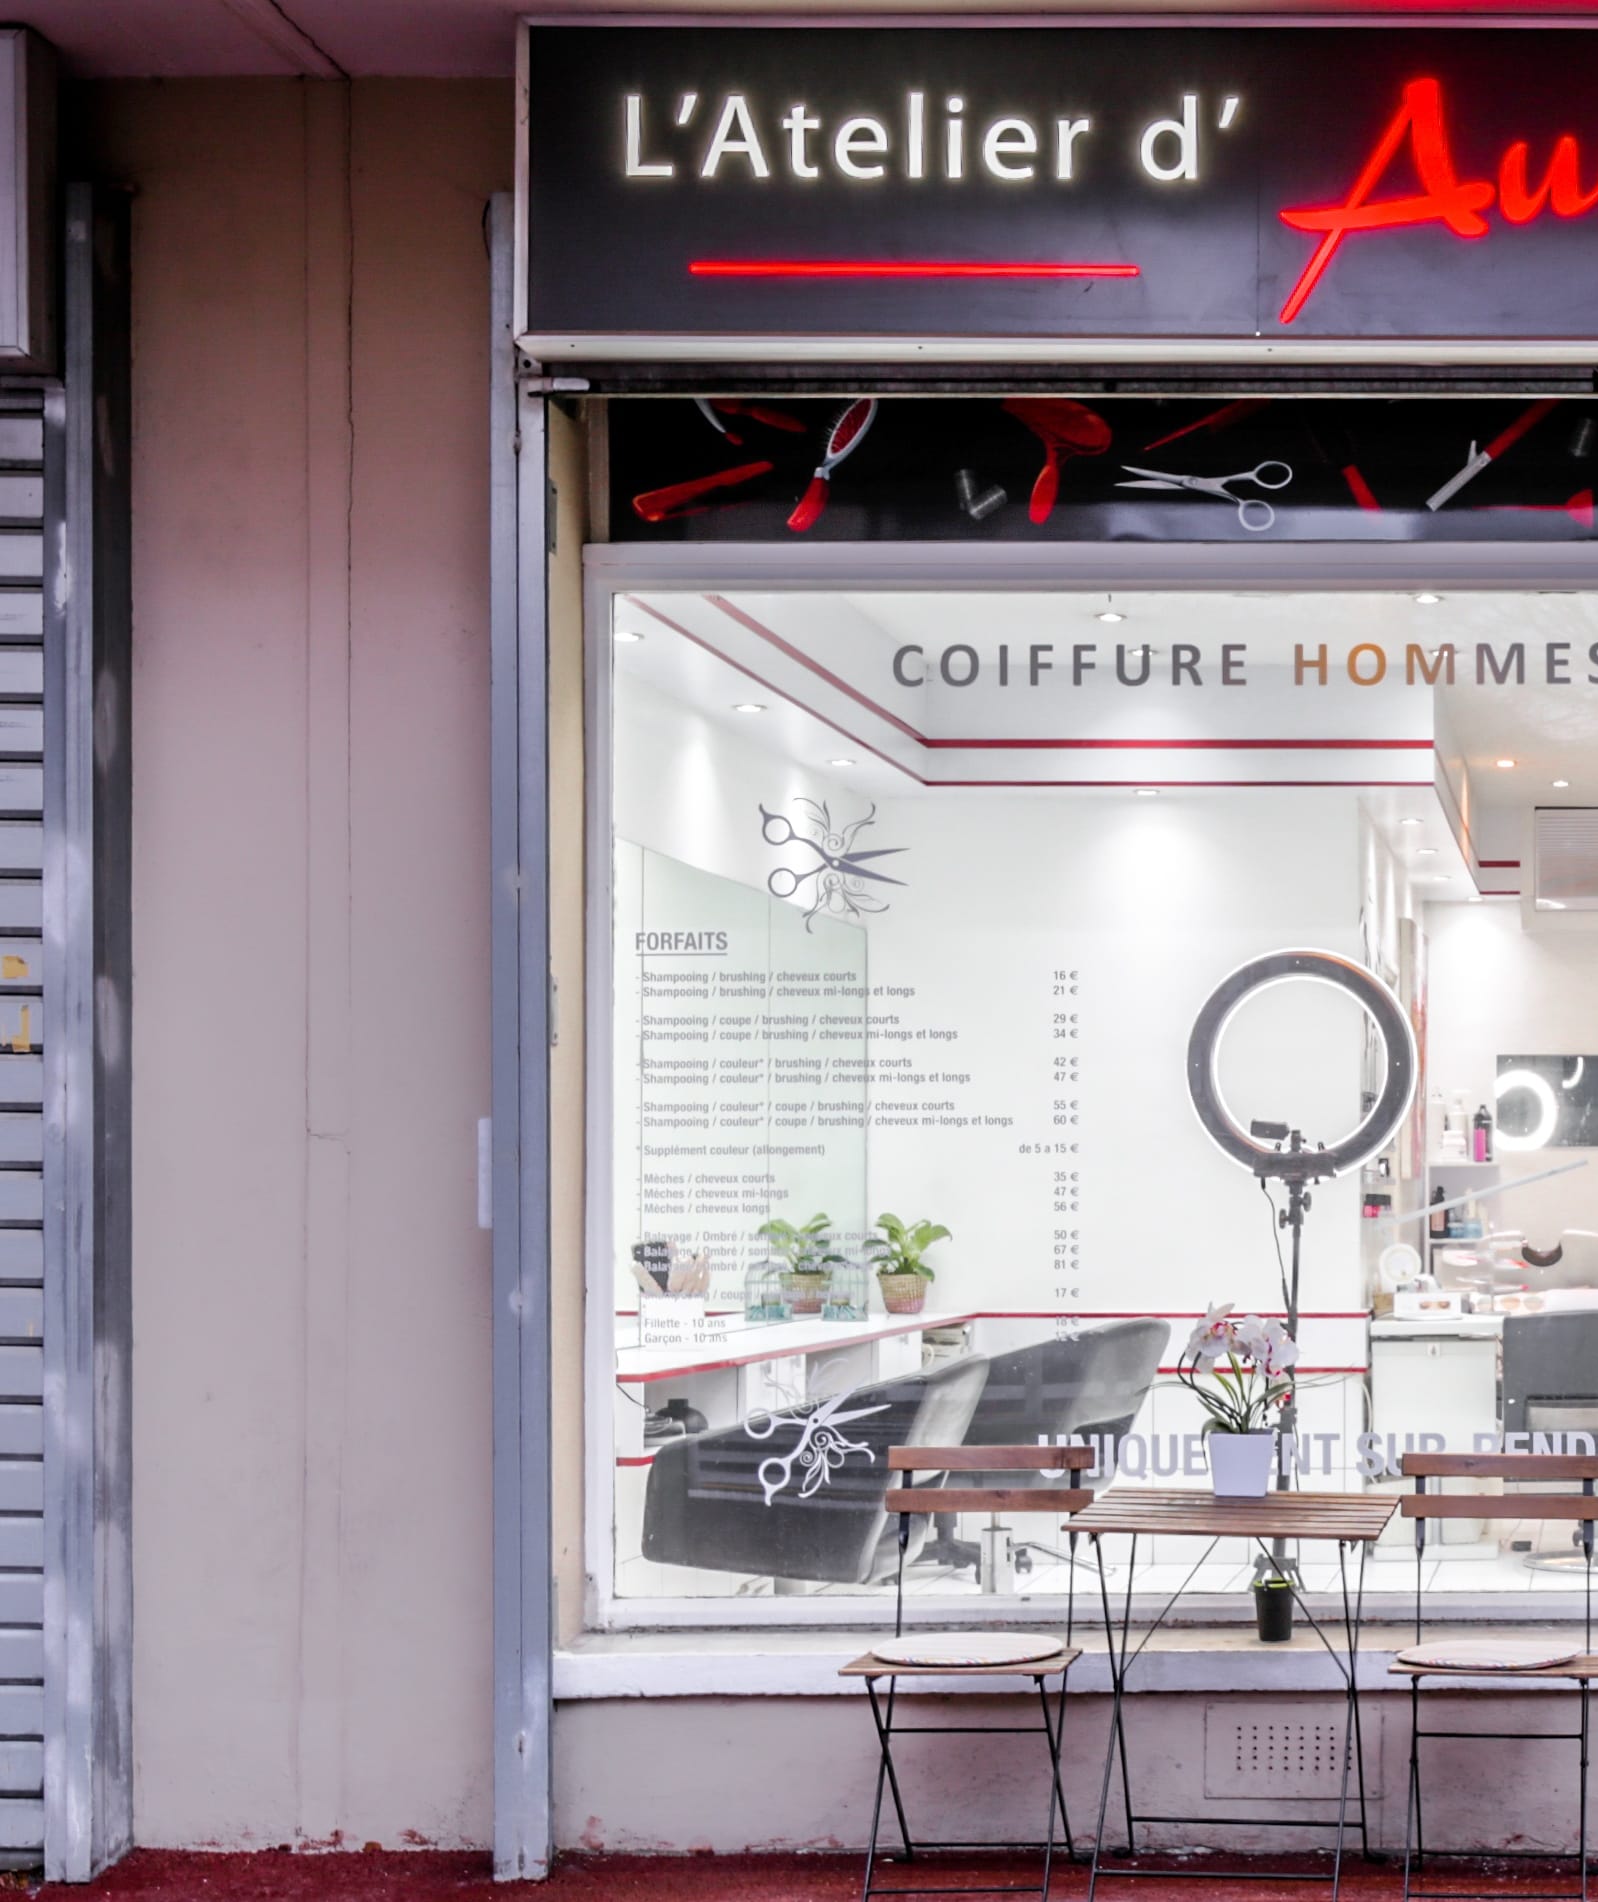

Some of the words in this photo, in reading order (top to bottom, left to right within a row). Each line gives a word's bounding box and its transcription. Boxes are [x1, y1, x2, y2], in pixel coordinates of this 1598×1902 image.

[625, 91, 1091, 180] L'Atelier
[1141, 92, 1240, 182] d'
[892, 642, 1247, 688] COIFFURE
[635, 931, 728, 951] FORFAITS
[642, 971, 708, 984] Shampooing
[720, 971, 766, 984] brushing
[776, 971, 820, 982] cheveux
[823, 971, 857, 982] courts
[1053, 970, 1067, 981] 16
[642, 986, 708, 998] Shampooing
[720, 986, 766, 998] brushing
[776, 986, 820, 996] cheveux
[873, 986, 884, 996] et
[886, 986, 916, 998] longs
[1053, 985, 1067, 996] 21
[642, 1014, 708, 1028] Shampooing
[720, 1014, 752, 1028] coupe
[762, 1014, 808, 1028] brushing
[819, 1014, 862, 1025] cheveux
[866, 1014, 900, 1025] courts
[1053, 1014, 1067, 1024] 29
[642, 1029, 708, 1042] Shampooing
[720, 1029, 752, 1042] coupe
[762, 1029, 808, 1042] brushing
[819, 1029, 862, 1040] cheveux
[866, 1029, 913, 1042] mi-longs
[916, 1029, 926, 1040] et
[929, 1029, 958, 1042] longs
[1053, 1028, 1067, 1039] 34
[642, 1058, 708, 1070] Shampooing
[775, 1058, 822, 1070] brushing
[879, 1058, 912, 1068] courts
[1053, 1056, 1067, 1067] 42
[642, 1073, 708, 1086] Shampooing
[775, 1073, 822, 1086] brushing
[879, 1073, 926, 1086] mi-longs
[928, 1073, 939, 1083] et
[942, 1073, 971, 1086] longs
[1053, 1072, 1067, 1082] 47
[642, 1101, 708, 1114] Shampooing
[775, 1101, 807, 1114] coupe
[818, 1101, 864, 1114] brushing
[874, 1101, 918, 1112] cheveux
[921, 1101, 955, 1112] courts
[1053, 1100, 1067, 1111] 55
[642, 1116, 708, 1129] Shampooing
[775, 1116, 807, 1129] coupe
[818, 1116, 864, 1129] brushing
[874, 1116, 918, 1126] cheveux
[921, 1116, 968, 1129] mi-longs
[971, 1116, 982, 1126] et
[984, 1116, 1014, 1129] longs
[1053, 1115, 1067, 1126] 60
[644, 1144, 706, 1158] Supplément
[710, 1145, 749, 1155] couleur
[1019, 1144, 1032, 1154] de
[1034, 1144, 1041, 1154] 5
[1055, 1144, 1067, 1154] 15
[695, 1174, 738, 1184] cheveux
[1053, 1172, 1067, 1182] 35
[695, 1188, 738, 1198] cheveux
[742, 1188, 788, 1201] mi-longs
[1053, 1186, 1067, 1197] 47
[695, 1203, 738, 1213] cheveux
[742, 1203, 770, 1216] longs
[1053, 1201, 1067, 1212] 56
[1053, 1230, 1067, 1240] 50
[1053, 1244, 1067, 1255] 67
[1053, 1259, 1067, 1270] 81
[1056, 1288, 1067, 1298] 17
[692, 1318, 704, 1329] 10
[708, 1318, 726, 1329] ans
